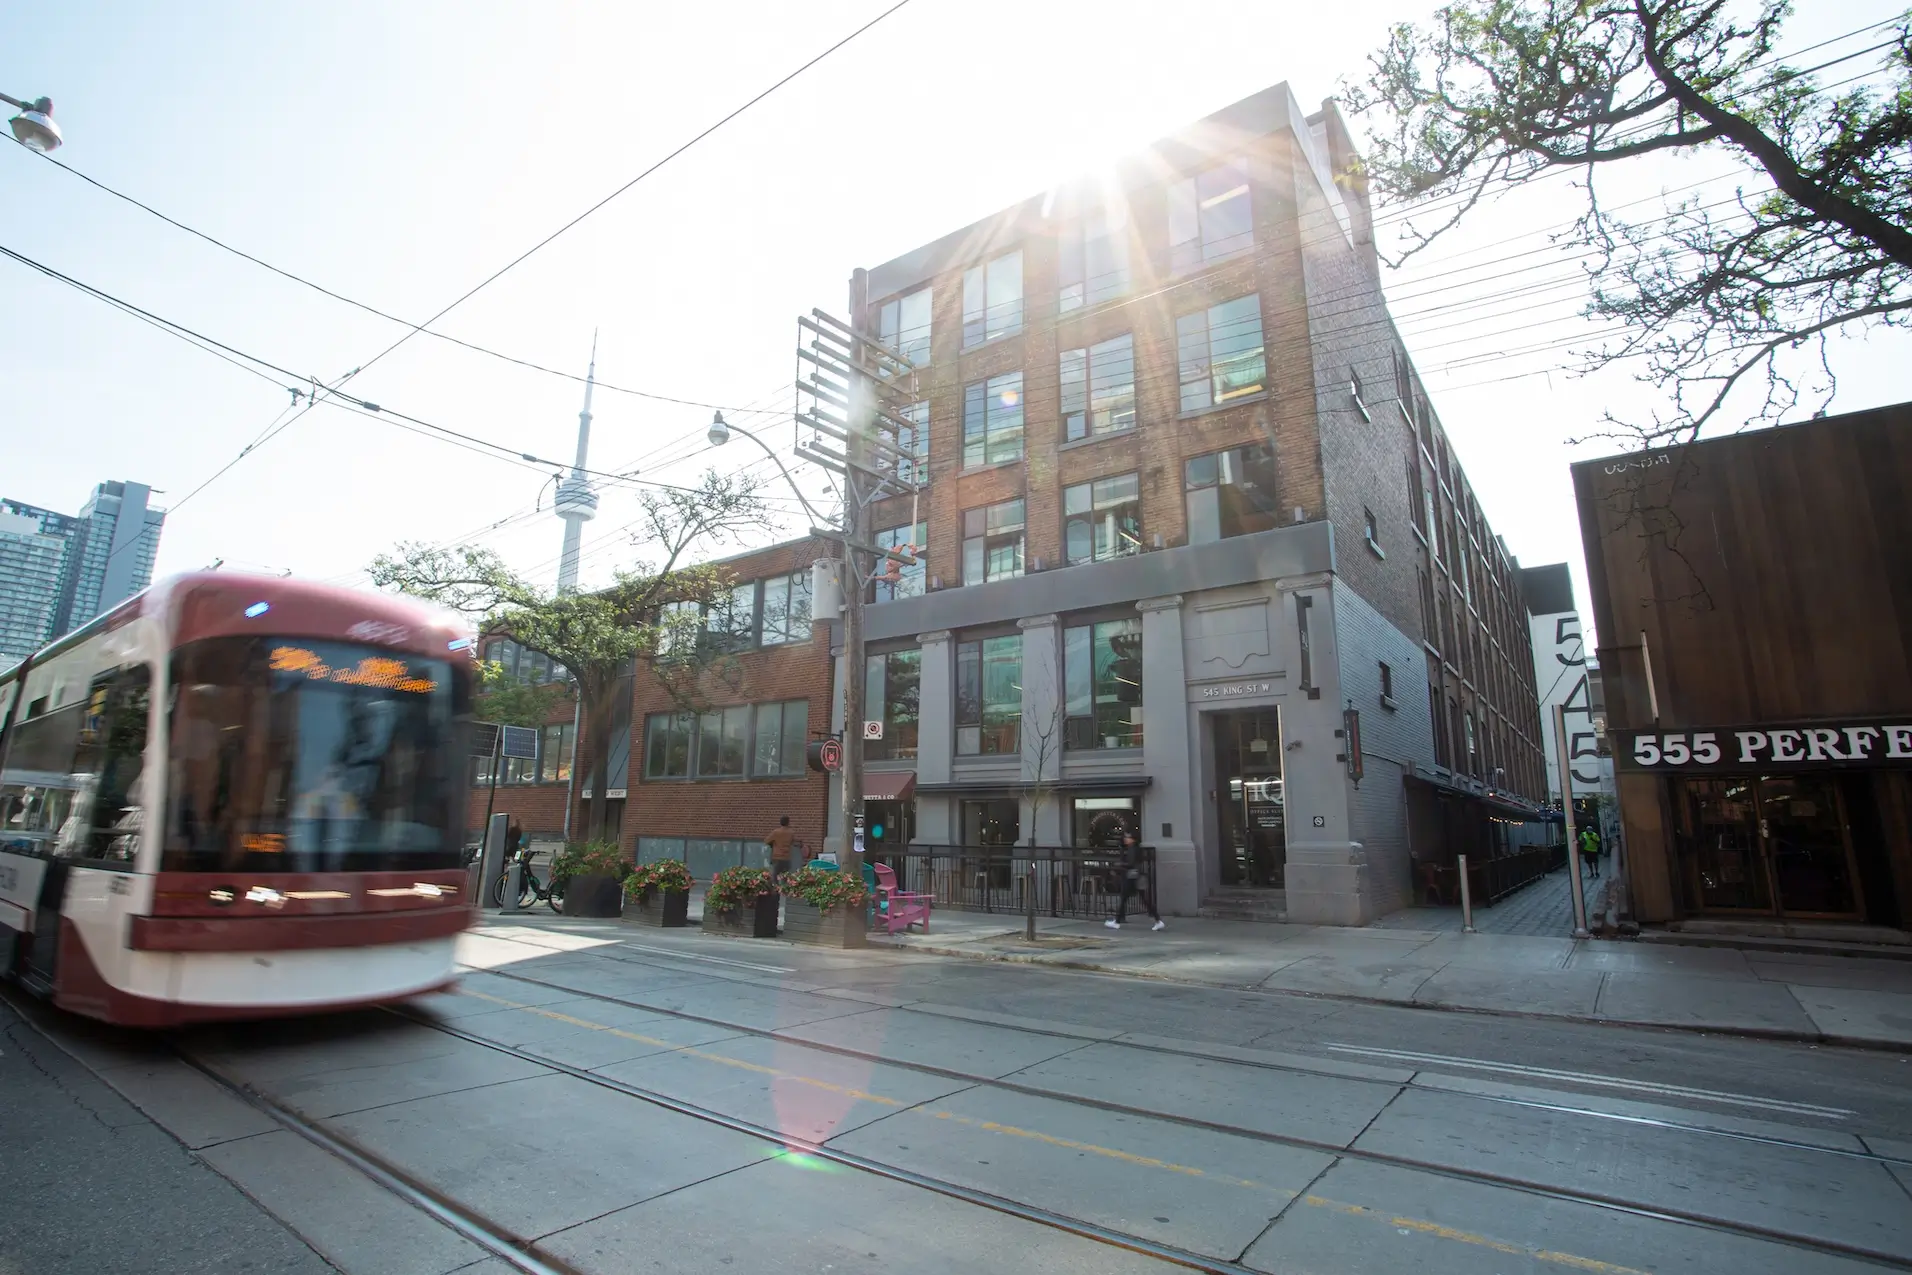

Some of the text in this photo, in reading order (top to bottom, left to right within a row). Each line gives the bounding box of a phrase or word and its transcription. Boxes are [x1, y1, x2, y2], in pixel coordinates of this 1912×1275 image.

[1203, 683, 1270, 697] 545 KING ST W
[1633, 725, 1912, 766] 555 PERFE
